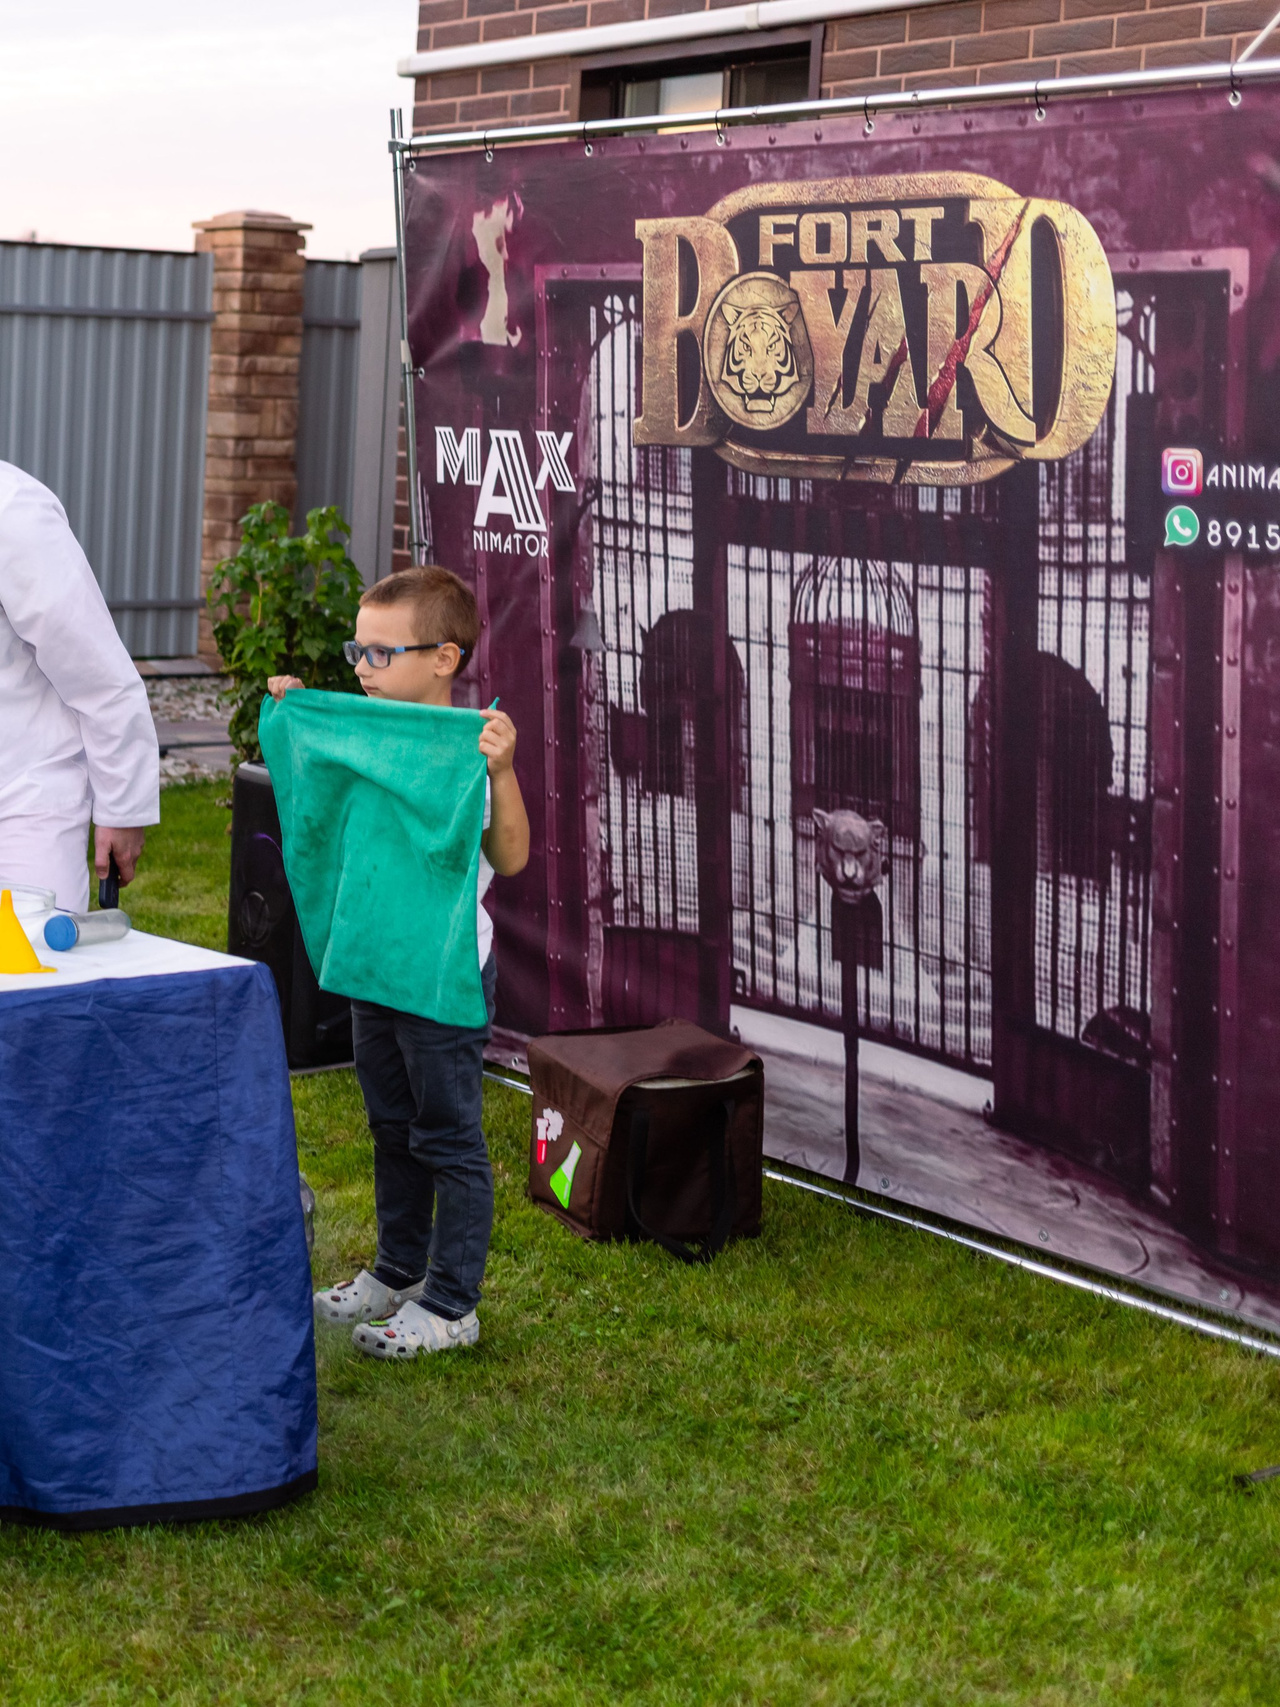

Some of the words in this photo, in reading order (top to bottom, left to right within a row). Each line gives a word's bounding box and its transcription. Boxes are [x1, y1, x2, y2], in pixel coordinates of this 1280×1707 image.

[758, 206, 945, 266] FORT
[633, 190, 1118, 463] BOYARD
[434, 426, 577, 532] MAX
[472, 530, 550, 558] NIMATOR
[1207, 519, 1280, 551] 8915
